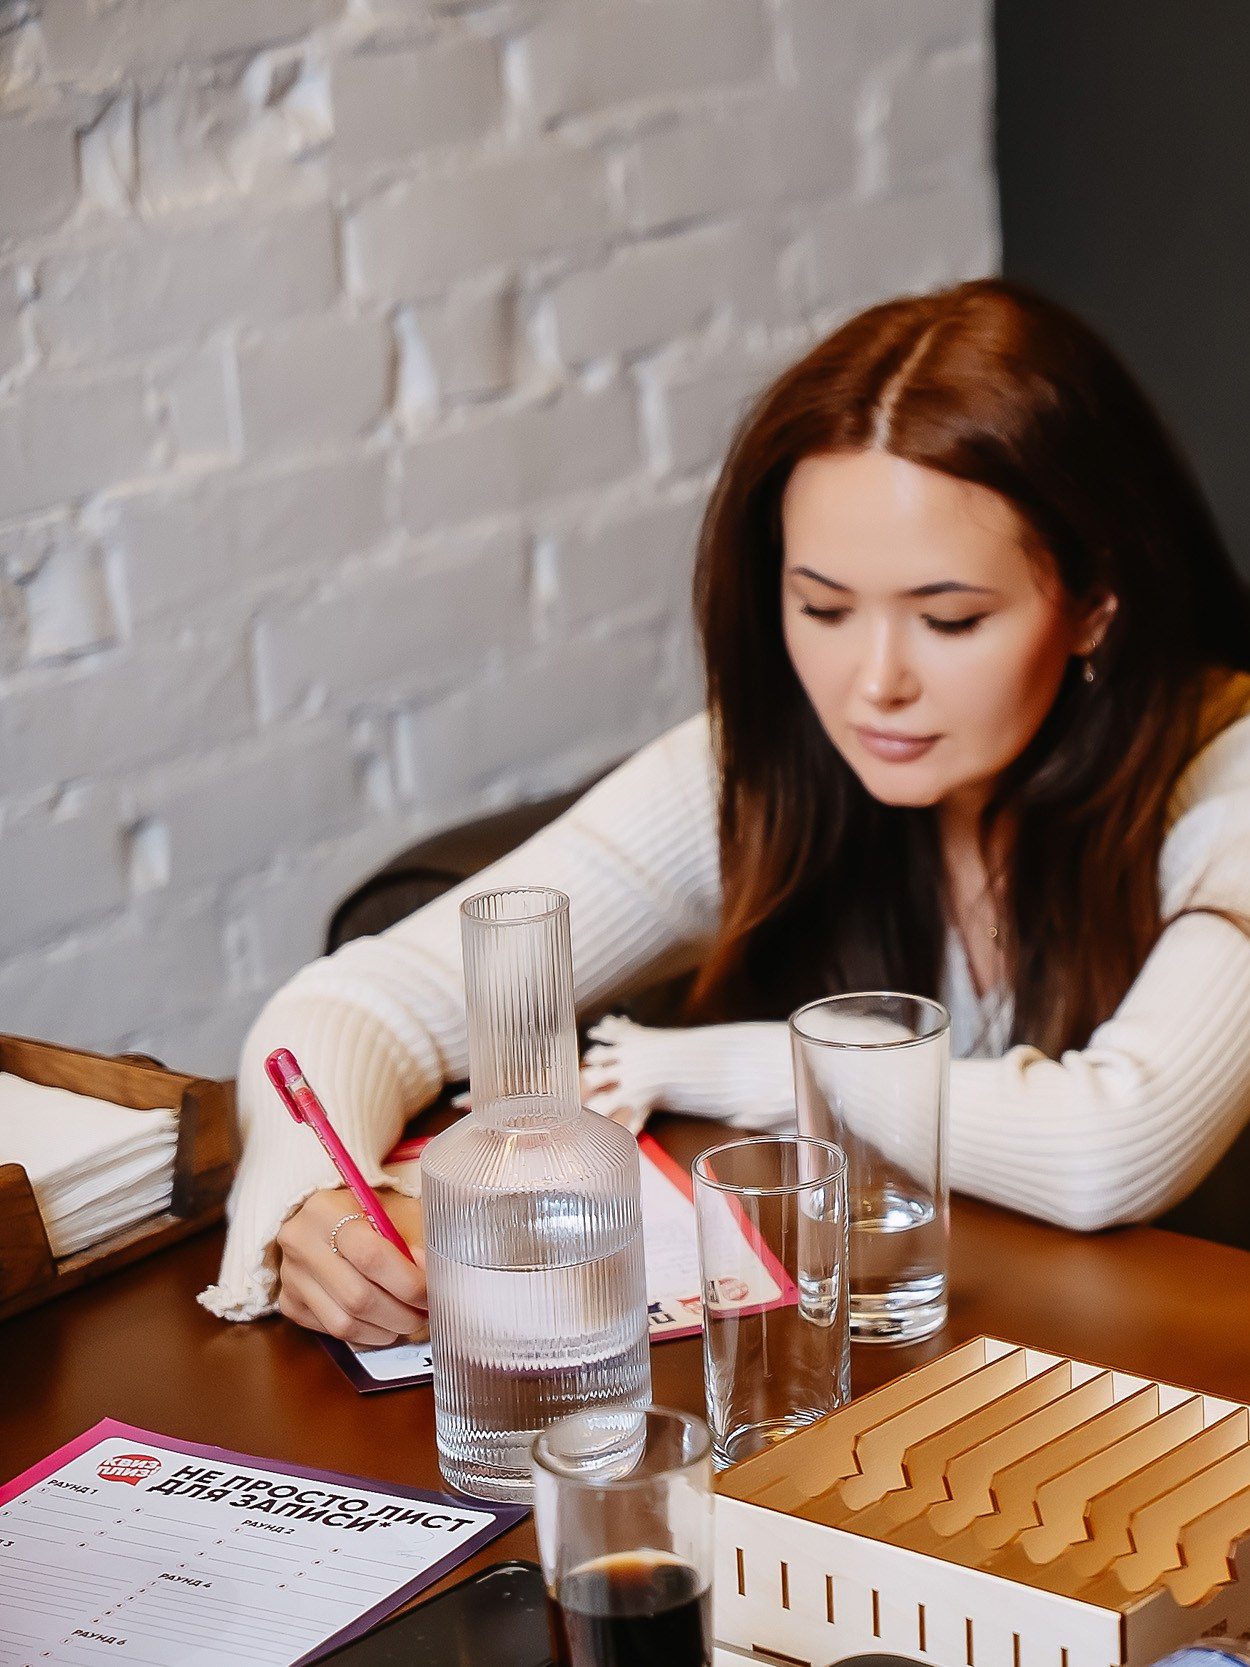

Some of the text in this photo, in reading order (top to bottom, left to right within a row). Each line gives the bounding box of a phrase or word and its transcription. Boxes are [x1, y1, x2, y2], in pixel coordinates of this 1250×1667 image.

[48, 1479, 91, 1494] РАУНД
[149, 1479, 232, 1503] ДЛЯ
[171, 1465, 475, 1533] НЕ ПРОСТО ЛИСТ
[241, 1519, 285, 1534] РАУНД
[158, 1572, 203, 1587] РАУНД
[71, 1629, 117, 1644] РАУНД
